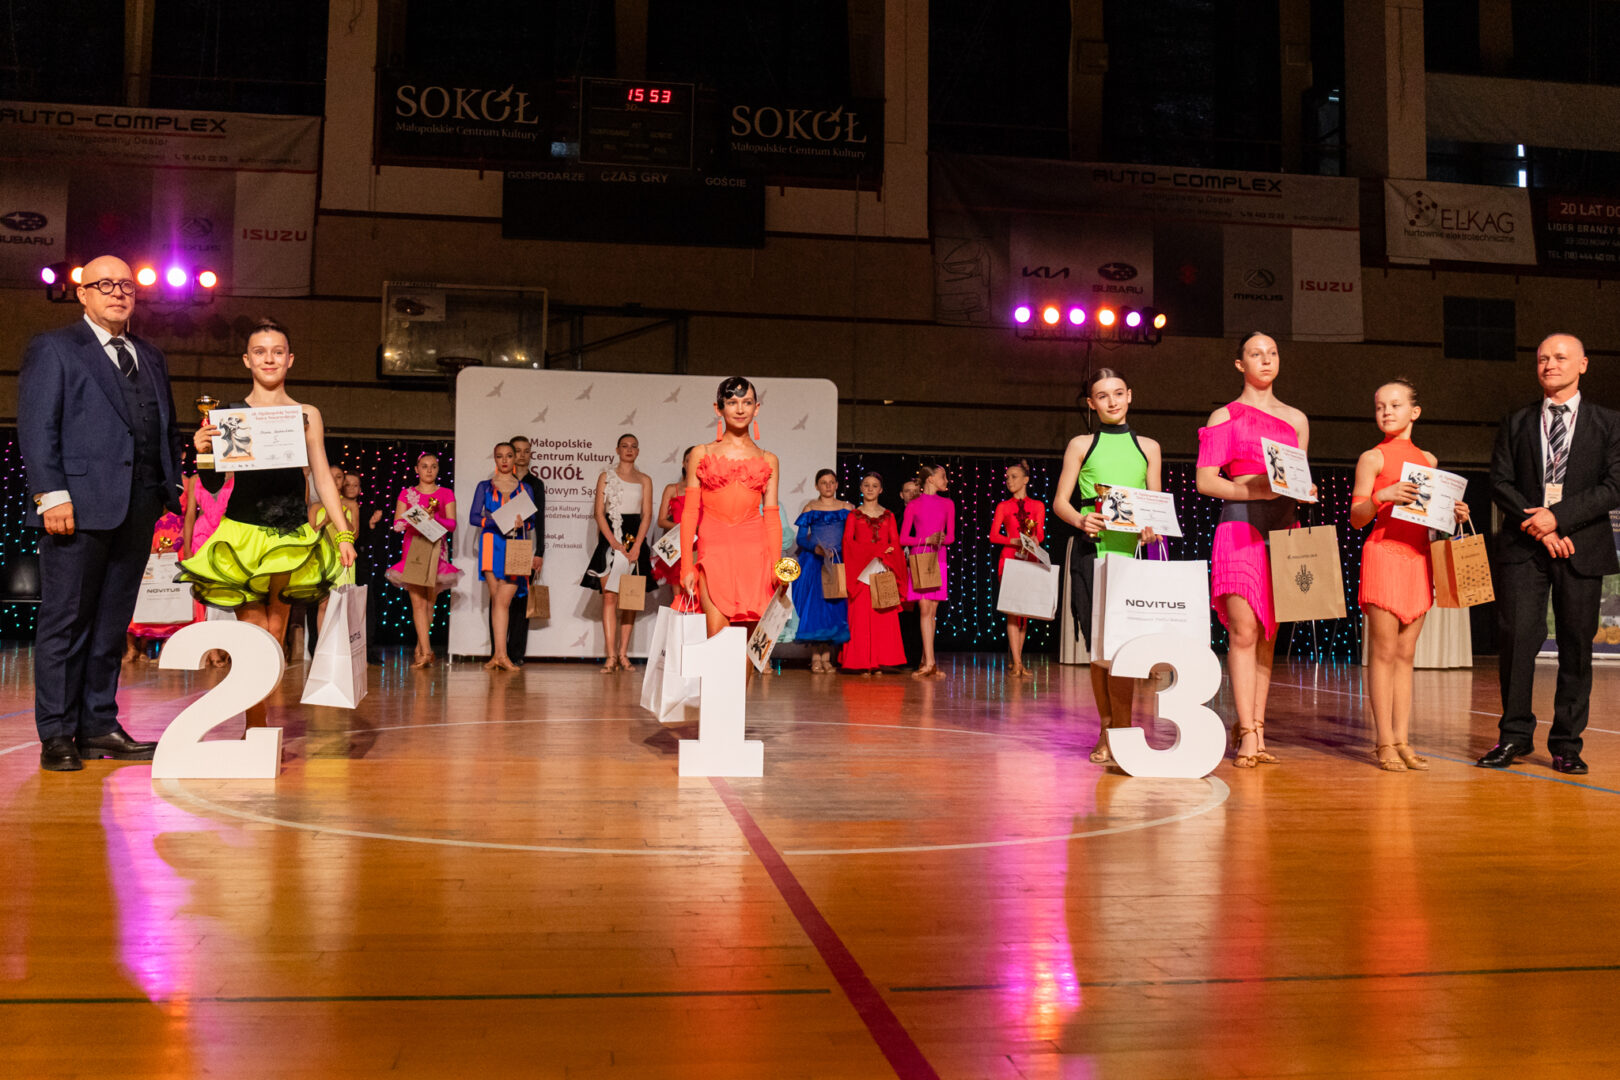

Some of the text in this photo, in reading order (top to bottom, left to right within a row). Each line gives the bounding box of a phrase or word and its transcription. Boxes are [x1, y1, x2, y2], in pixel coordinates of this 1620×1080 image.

[627, 88, 672, 104] 15 53
[395, 83, 540, 125] SOKÓŁ
[0, 108, 226, 133] AUTO-COMPLEX
[730, 104, 868, 144] SOKÓŁ
[395, 121, 537, 142] Małopolskie Centrum Kultury
[730, 141, 867, 160] Małopolskie Centrum Kultury
[507, 169, 585, 182] GOSPODARZE
[601, 171, 669, 184] CZAS GRY
[704, 175, 747, 188] GOŚCIE
[1093, 169, 1282, 193] AUTO-COMPLEX
[1560, 202, 1577, 216] 20
[1580, 203, 1603, 217] LAT
[1404, 227, 1443, 239] hurtownie
[1547, 222, 1574, 233] LIDER
[242, 228, 307, 242] ISUZU
[1022, 266, 1070, 279] KIA
[1092, 284, 1144, 295] SUBARU
[1300, 280, 1353, 292] ISUZU
[1233, 292, 1284, 301] MAXUS
[530, 438, 593, 450] Małopolskie
[530, 451, 615, 465] Centrum Kultury
[530, 464, 584, 481] SOKÓŁ
[559, 504, 581, 512] Kultury
[1125, 599, 1186, 609] NOVITUS
[152, 620, 284, 778] 2
[678, 626, 764, 777] 1
[1106, 632, 1227, 779] 3
